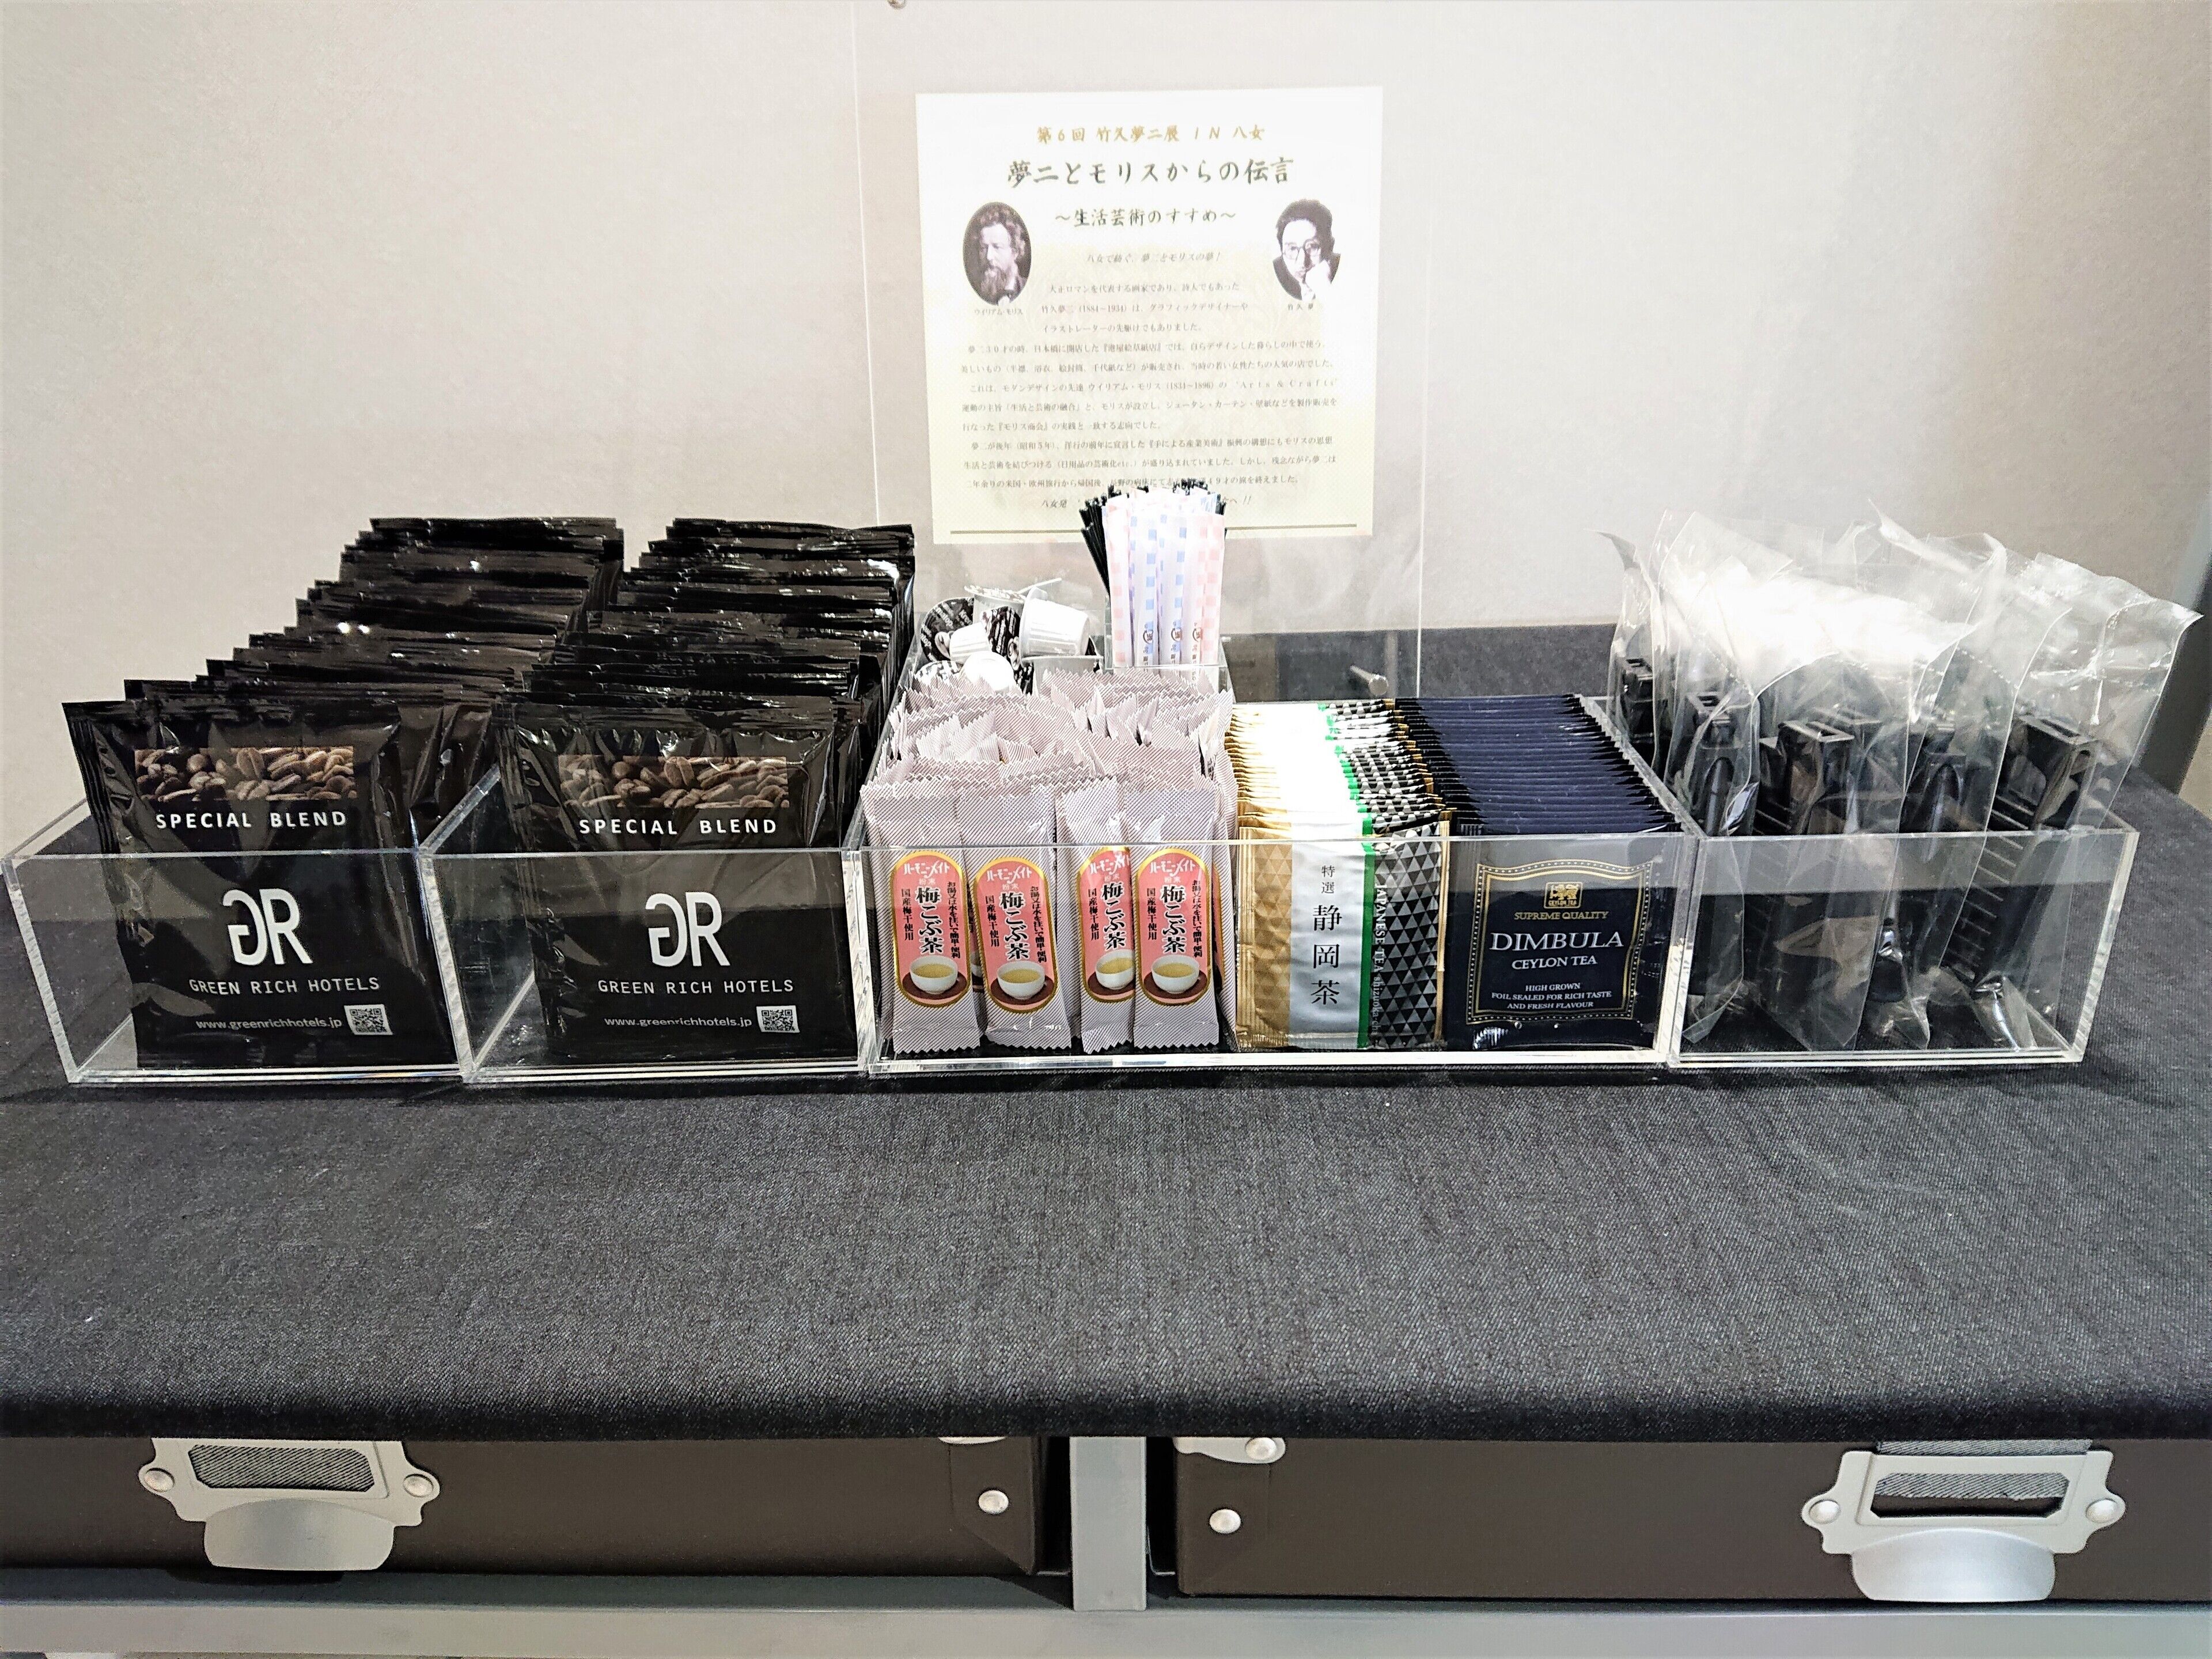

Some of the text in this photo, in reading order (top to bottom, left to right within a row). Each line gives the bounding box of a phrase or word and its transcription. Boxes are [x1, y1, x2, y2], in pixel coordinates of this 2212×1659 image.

[1096, 124, 1180, 144] 竹久夢二展
[1232, 123, 1265, 141] 八女
[1007, 156, 1294, 188] 夢二とモリスからの伝言
[156, 810, 347, 830] SPECIAL BLEND
[578, 818, 778, 835] SPECIAL BLEND
[903, 859, 950, 879] ハーモニーメイト
[986, 865, 1033, 884] ハーモニーメイト
[1149, 858, 1196, 877] ハーモニーメイト
[1321, 865, 1336, 895] 特選
[901, 888, 914, 941] 国産梅干使用
[915, 886, 945, 955] 梅こぶ茶
[985, 895, 1000, 948] 国産梅干使用
[1088, 888, 1100, 941] 国産梅干使用
[1101, 882, 1126, 951] 梅こぶ茶
[1146, 887, 1157, 941] 国産梅干使用
[1160, 885, 1187, 954] 梅こぶ茶
[1374, 883, 1388, 945] JAPANESE
[1513, 911, 1609, 920] SUPREME QUALITY
[999, 891, 1030, 960] 梅こぶ茶
[1488, 931, 1625, 952] DIMBULA
[1310, 904, 1343, 1006] 静岡茶
[1373, 948, 1385, 972] TEA
[1511, 955, 1598, 970] CEYLON TEA
[188, 976, 380, 995] GREEN RICH HOTELS
[597, 978, 794, 995] GREEN RICH HOTELS
[1491, 990, 1612, 1001] FOIL SEALED FOR RICH TASTE
[1525, 982, 1581, 992] HIGH GROWN
[1506, 1002, 1527, 1010] AND
[1555, 1001, 1594, 1009] FLAVOUR
[195, 1016, 343, 1031] www.greenrichhotels.jp
[604, 1015, 753, 1029] www.greenrichhotels.jp
